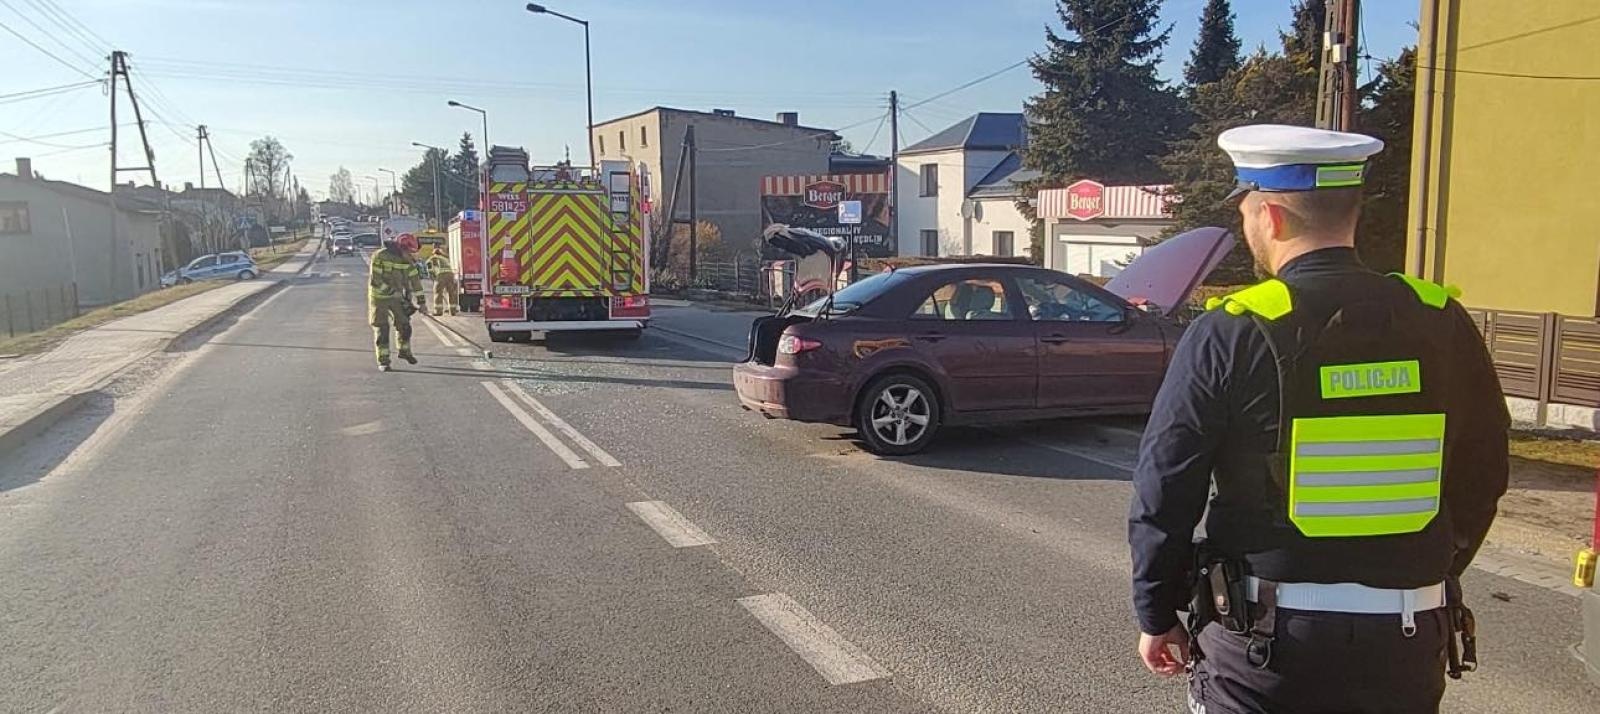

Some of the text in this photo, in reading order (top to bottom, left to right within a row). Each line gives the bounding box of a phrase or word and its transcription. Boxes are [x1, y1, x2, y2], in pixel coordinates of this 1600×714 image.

[809, 190, 842, 203] Berger
[1071, 193, 1100, 211] Berger
[1329, 366, 1412, 392] POLICJA
